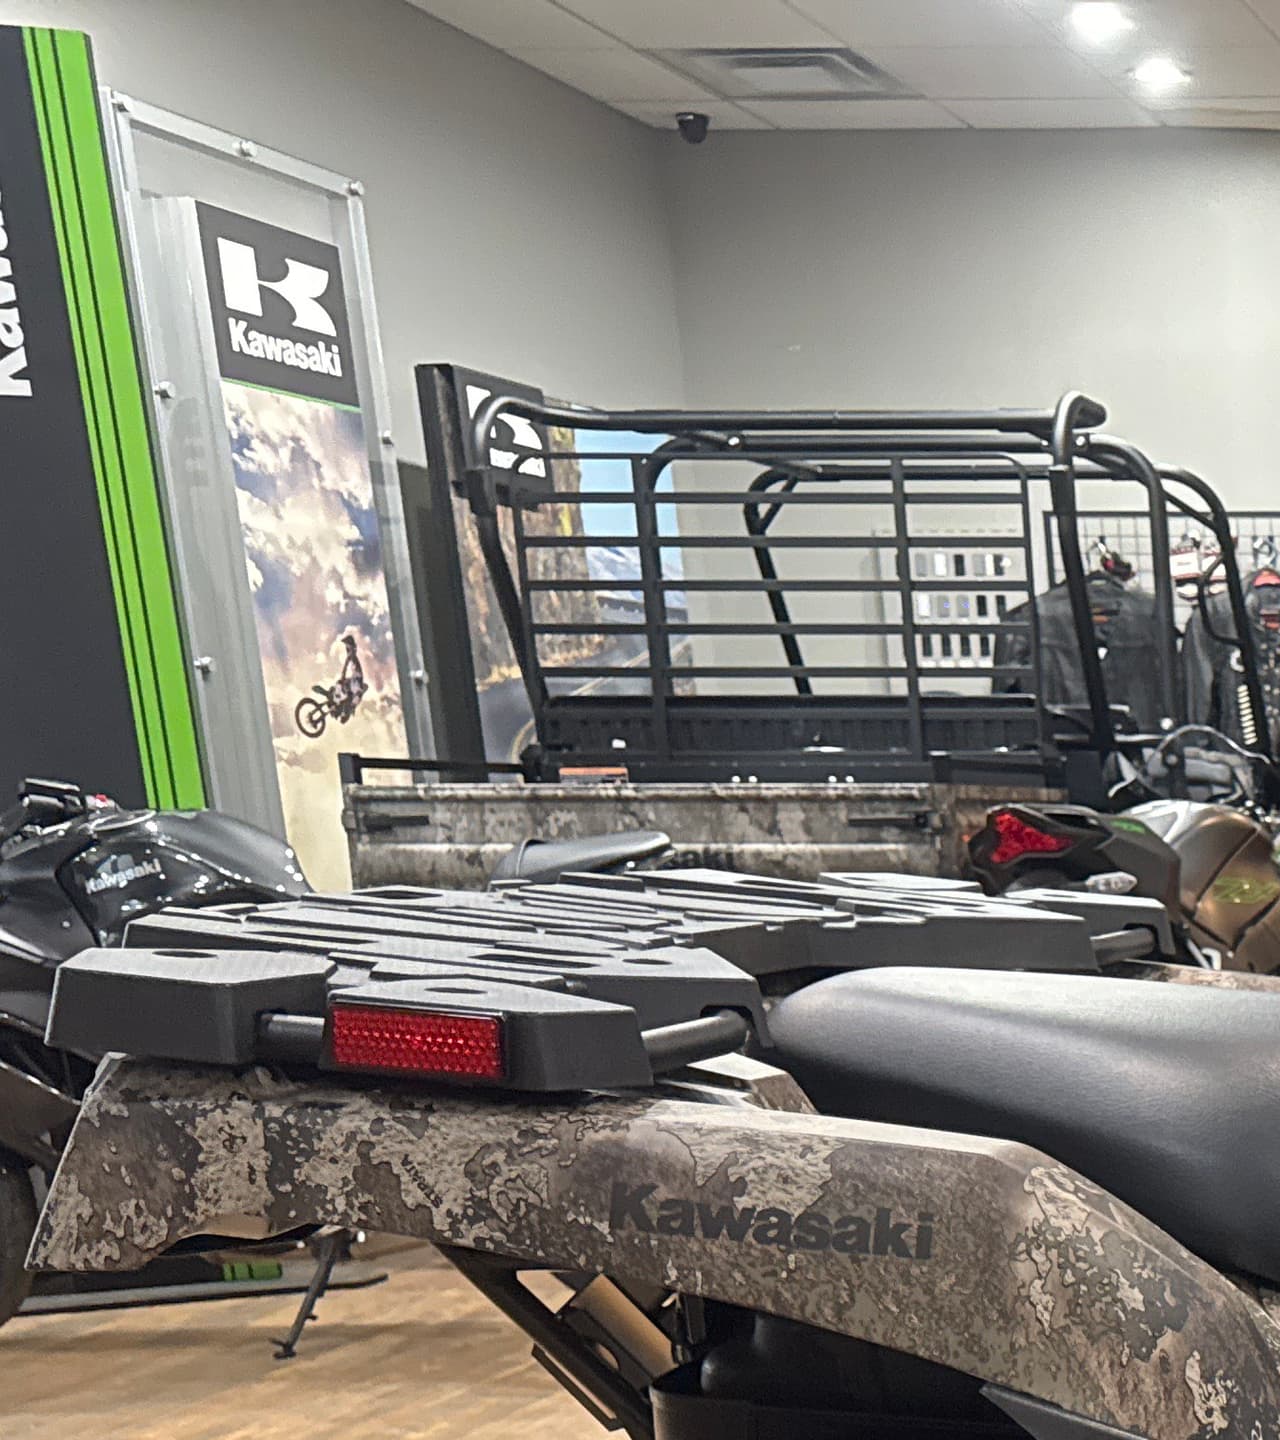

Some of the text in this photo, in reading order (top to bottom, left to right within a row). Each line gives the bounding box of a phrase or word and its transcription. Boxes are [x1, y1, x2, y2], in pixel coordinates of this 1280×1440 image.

[228, 316, 343, 377] Kawasaki
[85, 858, 162, 894] Kawasaki
[609, 1182, 934, 1261] Kawasaki
